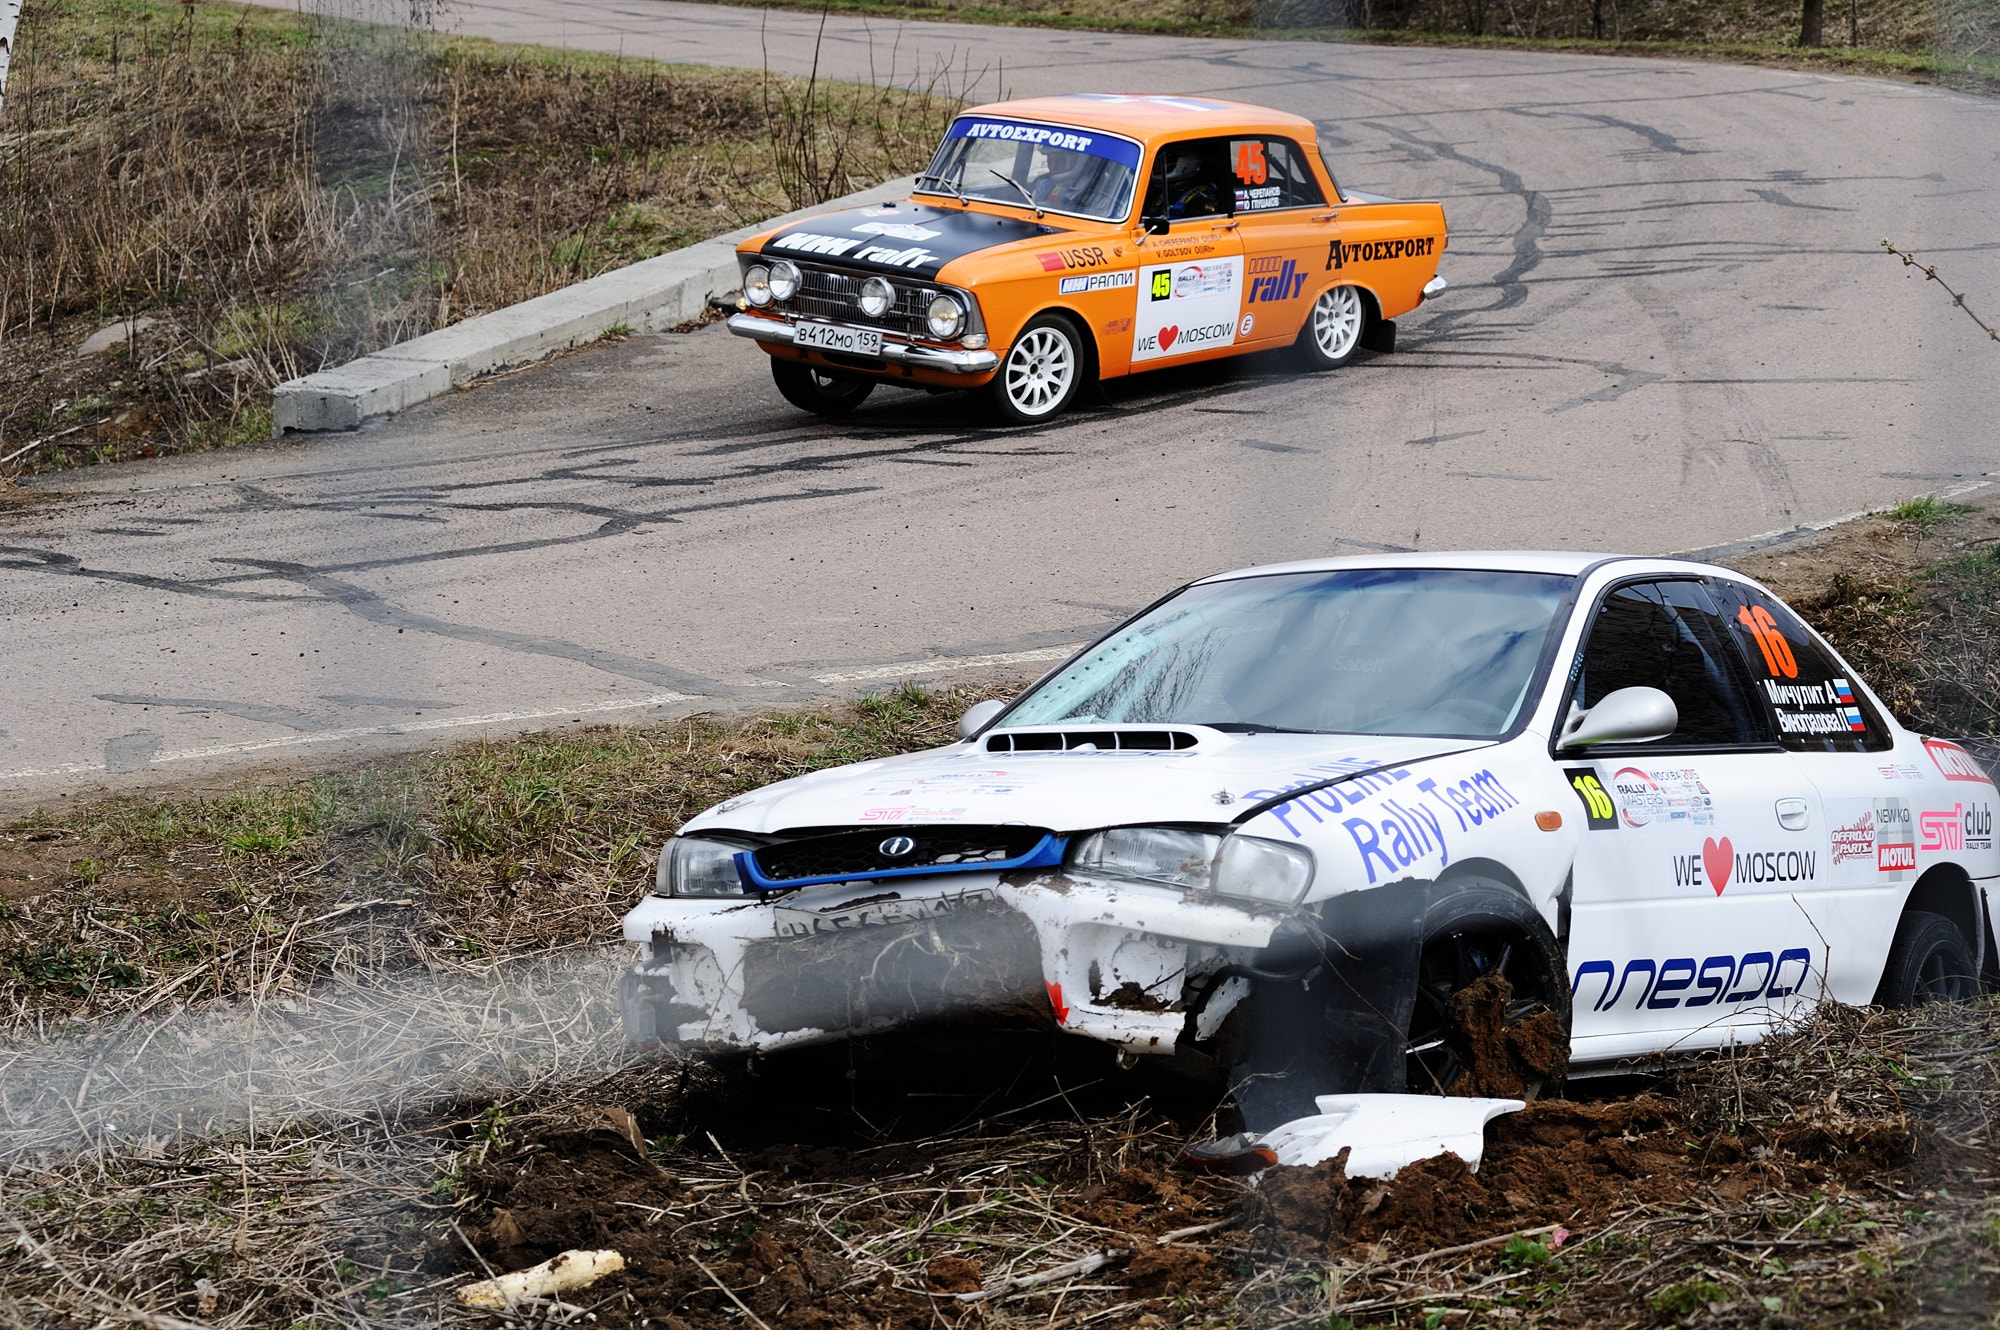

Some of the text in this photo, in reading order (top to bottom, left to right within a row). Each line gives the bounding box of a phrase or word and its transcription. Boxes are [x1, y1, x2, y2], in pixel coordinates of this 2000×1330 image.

[966, 123, 1093, 152] AVTOEXPORT
[1236, 143, 1267, 185] 45
[853, 245, 939, 269] rally
[1060, 246, 1108, 269] USSR
[1163, 247, 1192, 258] GOLTSOV
[1325, 237, 1434, 270] AVTOEXPORT
[1152, 273, 1170, 299] 45
[1248, 259, 1309, 304] rally
[856, 331, 877, 348] 159
[1138, 322, 1234, 352] WE MOSCOW
[1738, 605, 1798, 679] 16
[1763, 679, 1825, 711] Мичулит
[1775, 708, 1843, 735] Виноградова
[1929, 746, 1989, 780] MOTUL
[1573, 775, 1613, 820] 16
[1617, 784, 1647, 795] RALLY
[1621, 793, 1664, 806] MASTERS
[1342, 768, 1520, 884] Rally Team
[1965, 803, 1992, 836] club
[1831, 830, 1875, 843] OFFROAD
[1673, 850, 1816, 887] WE MOSCOW
[1880, 847, 1914, 868] MOTUL
